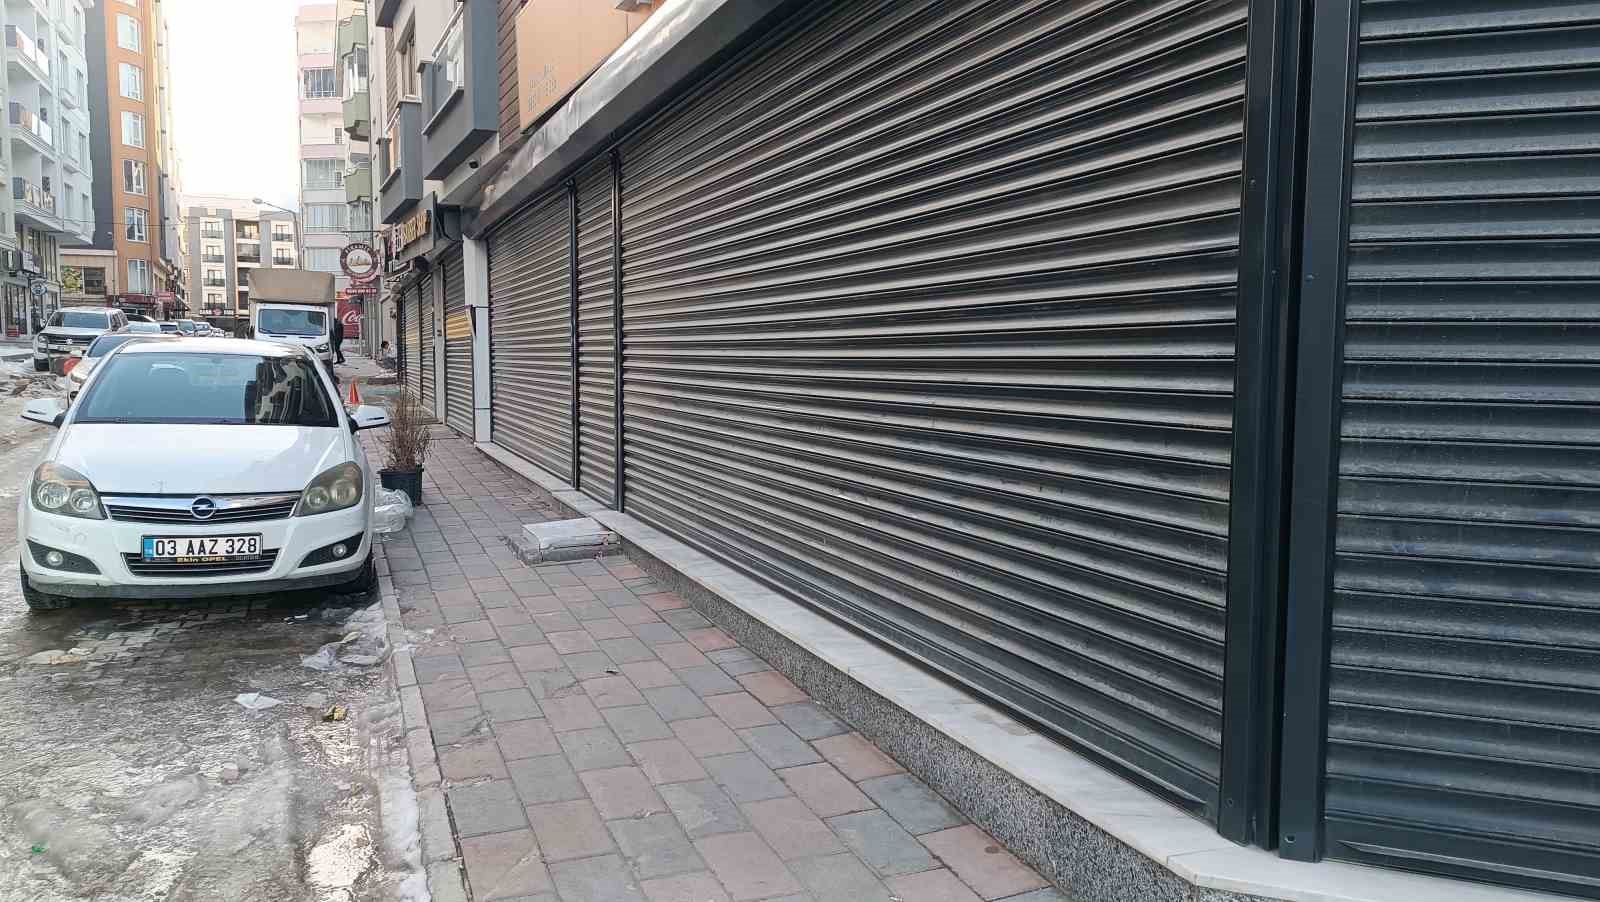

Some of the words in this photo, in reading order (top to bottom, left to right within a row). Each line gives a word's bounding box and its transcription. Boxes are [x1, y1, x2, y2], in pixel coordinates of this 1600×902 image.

[155, 540, 177, 556] 03
[186, 539, 219, 555] AAZ
[225, 537, 257, 554] 328
